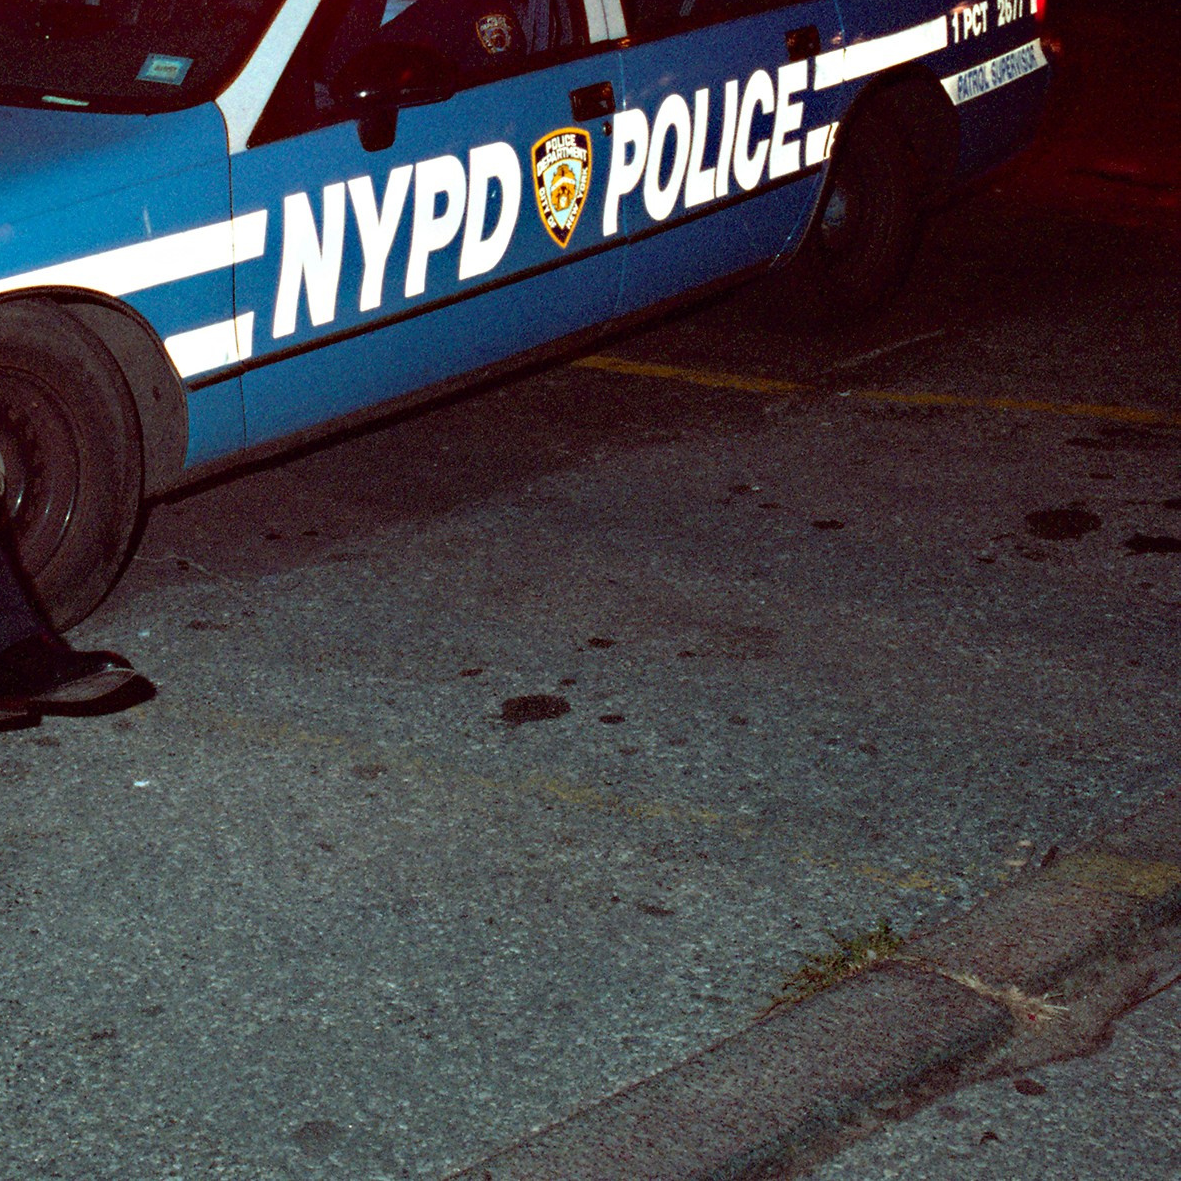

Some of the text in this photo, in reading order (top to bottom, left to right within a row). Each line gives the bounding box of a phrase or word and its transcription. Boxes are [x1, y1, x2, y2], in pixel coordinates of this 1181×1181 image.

[951, 11, 960, 44] 1
[963, 0, 989, 40] PCT
[957, 44, 1037, 101] PATROL SUPERVISOR
[536, 146, 588, 177] DEPARTMENT
[545, 134, 577, 153] POLICE
[272, 62, 808, 339] NYPD POLICE
[538, 186, 558, 229] CITY OF
[565, 166, 589, 230] NEW YORK
